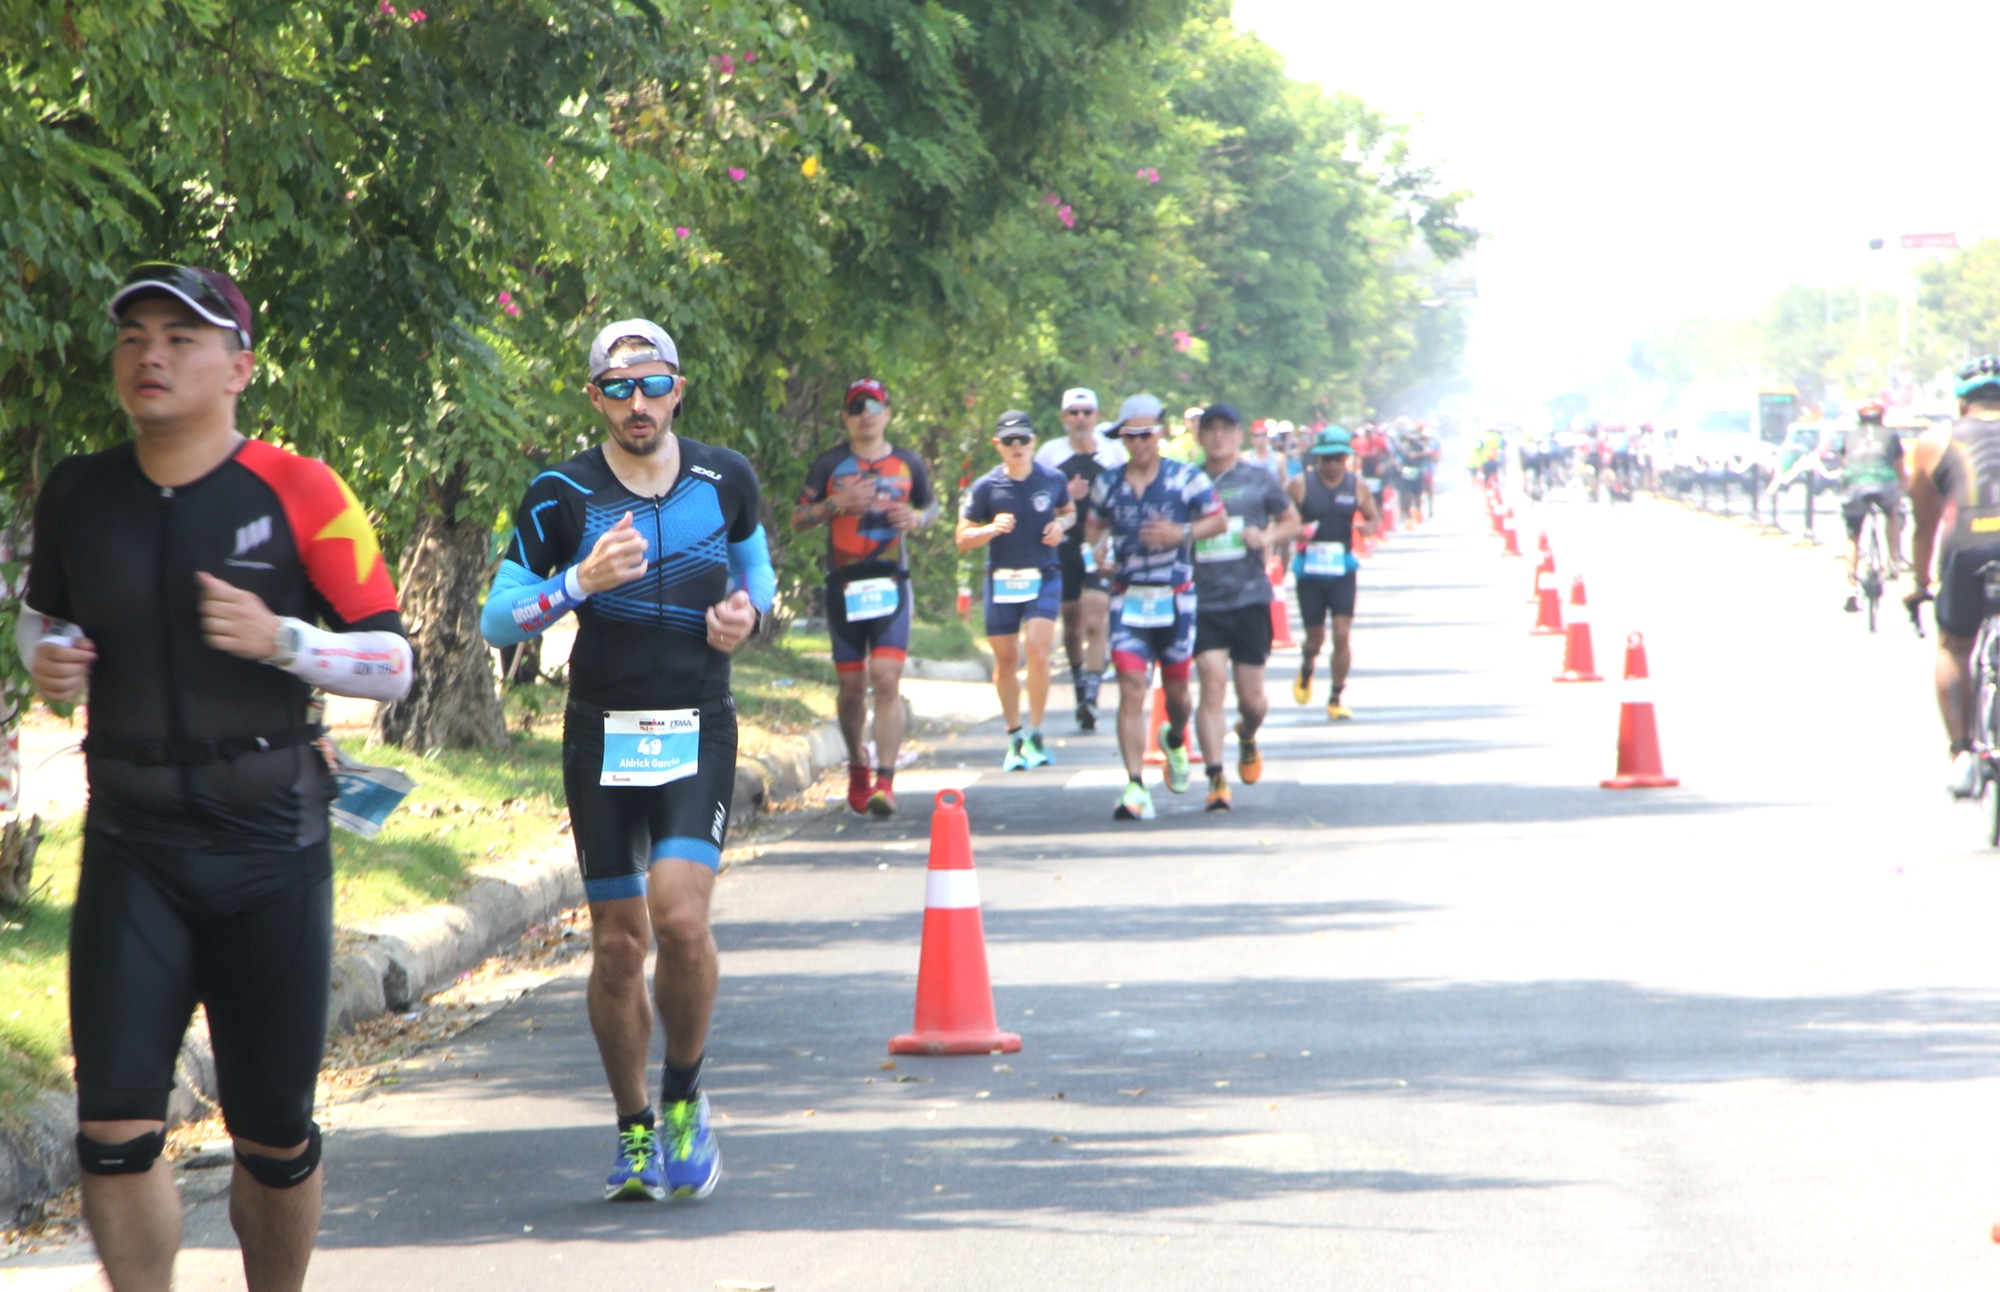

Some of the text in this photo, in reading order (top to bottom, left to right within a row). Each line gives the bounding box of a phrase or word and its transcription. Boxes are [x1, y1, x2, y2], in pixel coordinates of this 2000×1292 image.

[637, 738, 662, 755] 49
[619, 758, 680, 768] Aldrick Garcia
